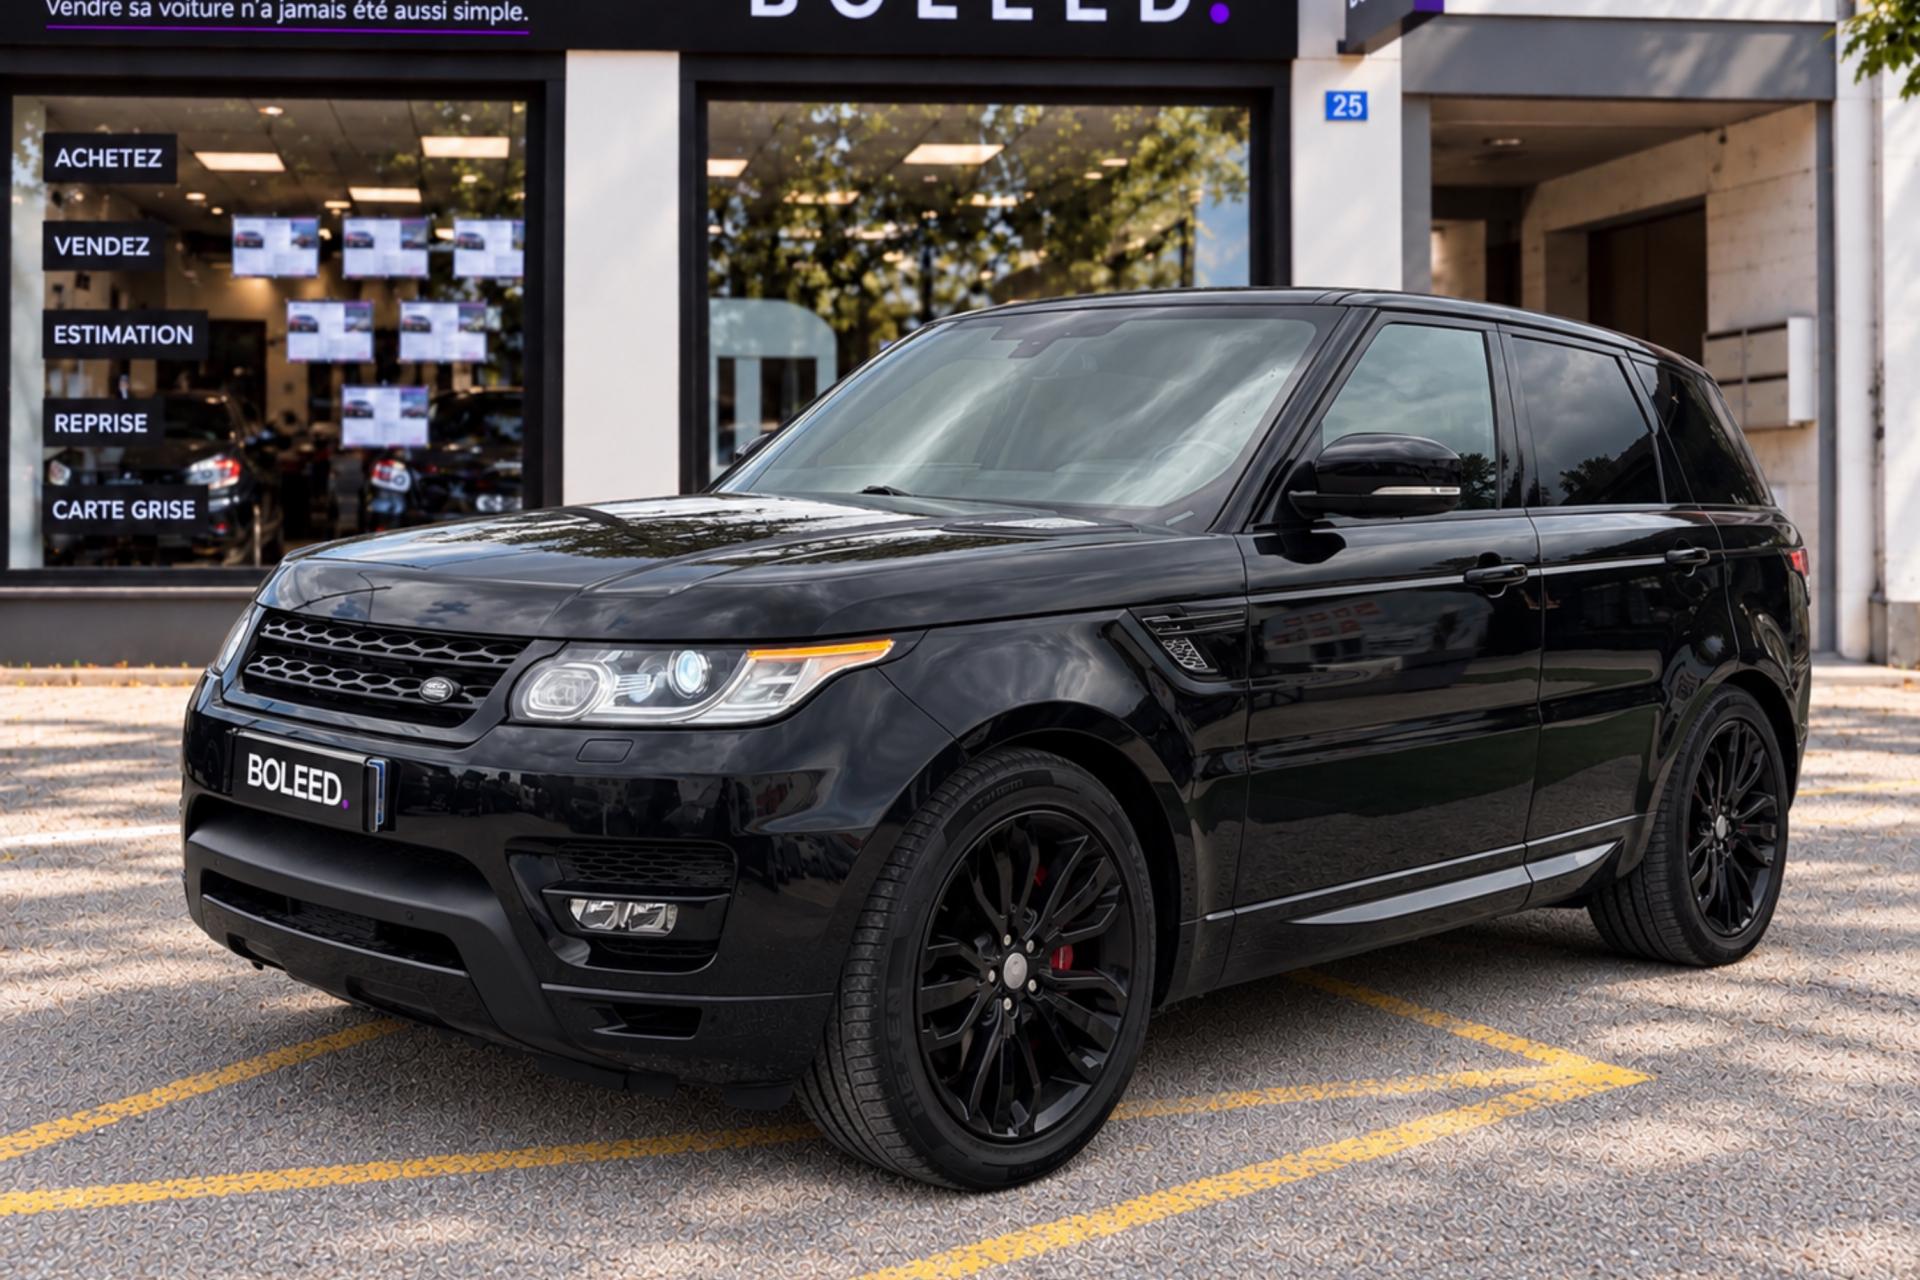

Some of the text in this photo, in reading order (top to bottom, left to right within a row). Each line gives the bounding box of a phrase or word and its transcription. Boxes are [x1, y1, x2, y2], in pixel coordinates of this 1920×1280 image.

[46, 0, 122, 16] Vendre
[129, 1, 151, 17] sa
[159, 0, 234, 18] voiture
[277, 0, 346, 24] jamais
[353, 0, 388, 19] été
[394, 0, 447, 20] aussi
[453, 1, 529, 26] simple.
[1333, 94, 1362, 117] 25
[55, 148, 163, 168] ACHETEZ
[55, 237, 150, 256] VENDEZ
[54, 325, 193, 344] ESTIMATION
[55, 414, 147, 433] REPRISE
[53, 500, 195, 520] CARTE GRISE
